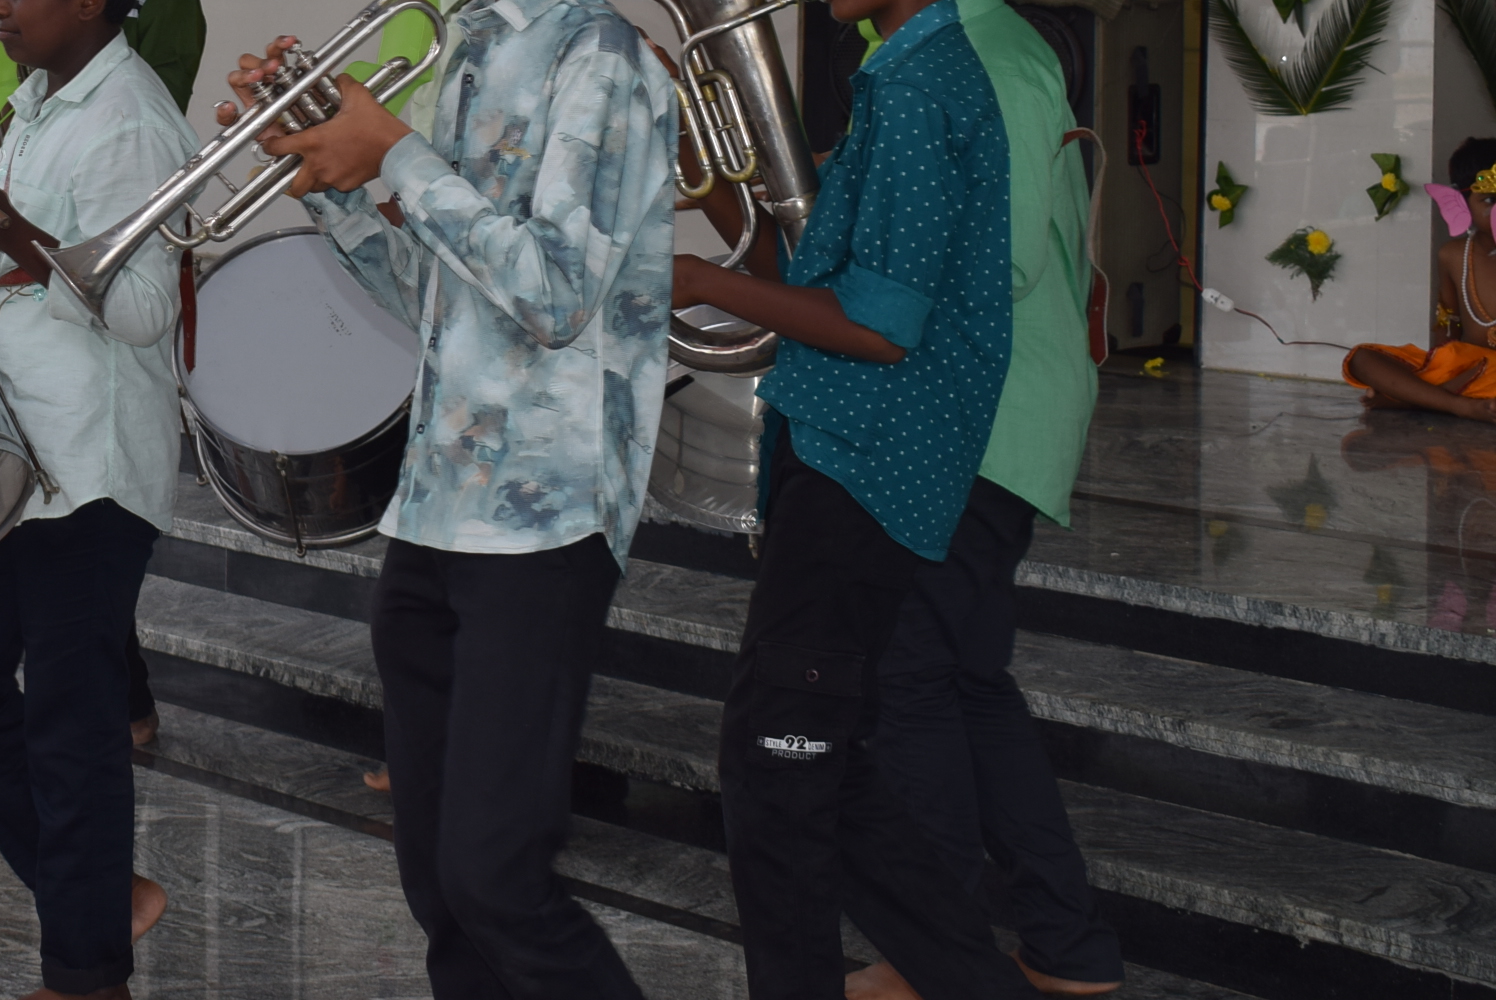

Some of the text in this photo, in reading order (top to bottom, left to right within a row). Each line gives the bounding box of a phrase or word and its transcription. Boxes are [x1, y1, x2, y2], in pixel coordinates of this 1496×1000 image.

[765, 739, 783, 748] STYLE
[785, 736, 807, 750] 92
[771, 749, 817, 760] PRODUCT
